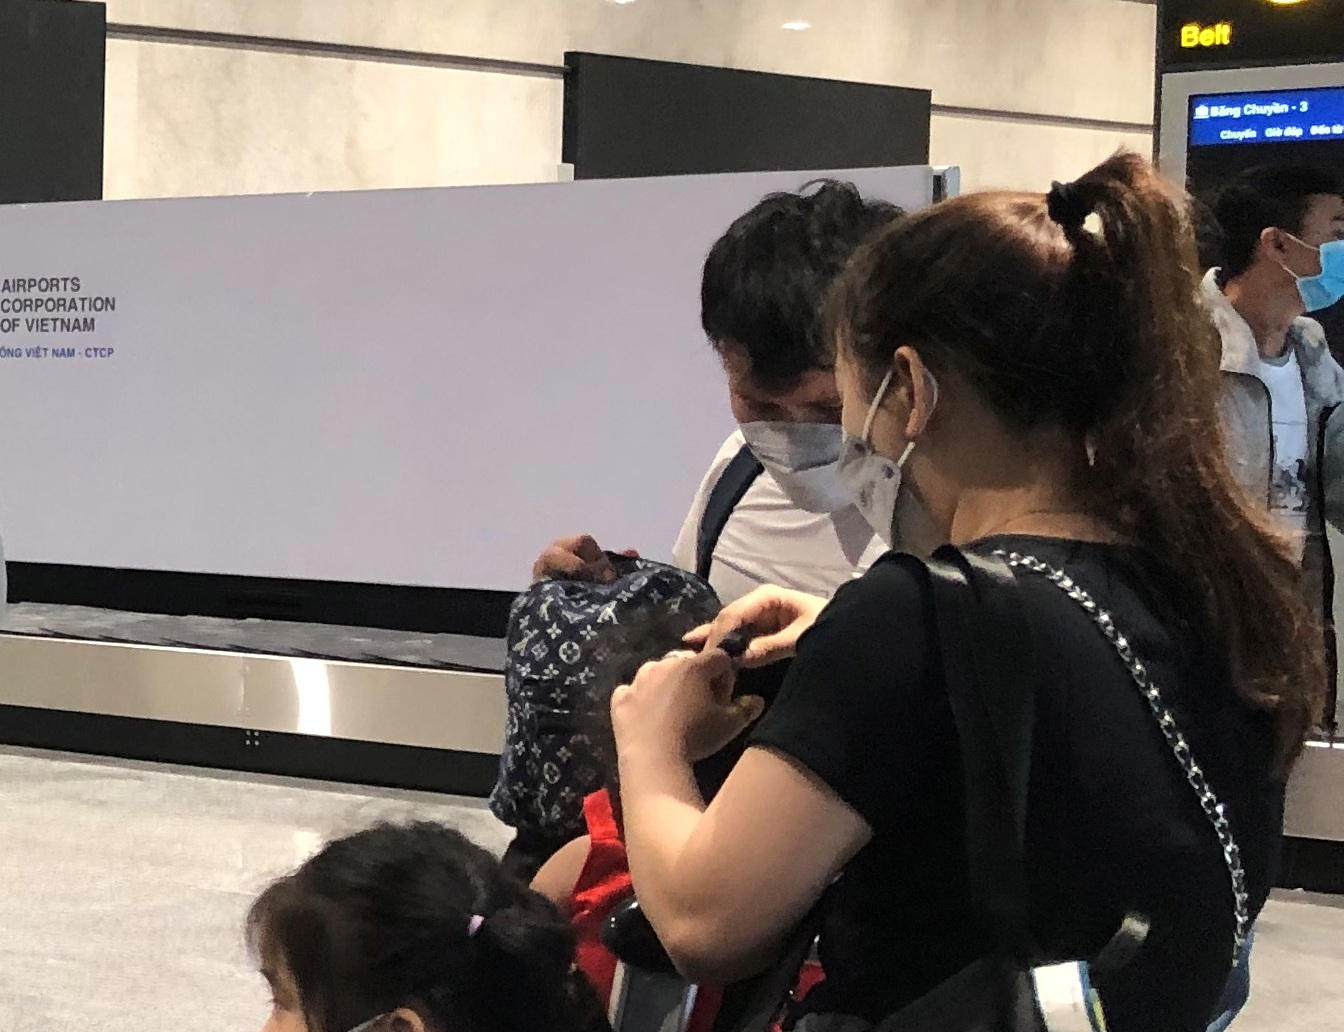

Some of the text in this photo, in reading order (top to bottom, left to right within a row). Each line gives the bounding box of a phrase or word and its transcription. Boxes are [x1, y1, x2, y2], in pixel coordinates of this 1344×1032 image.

[1180, 23, 1231, 47] Belt
[1300, 101, 1308, 112] 3
[1, 276, 80, 293] AIRPORTS
[0, 296, 116, 313] CORPORATION
[0, 317, 95, 333] OF VIETNAM
[51, 347, 76, 358] NAM
[84, 347, 115, 358] CTCP
